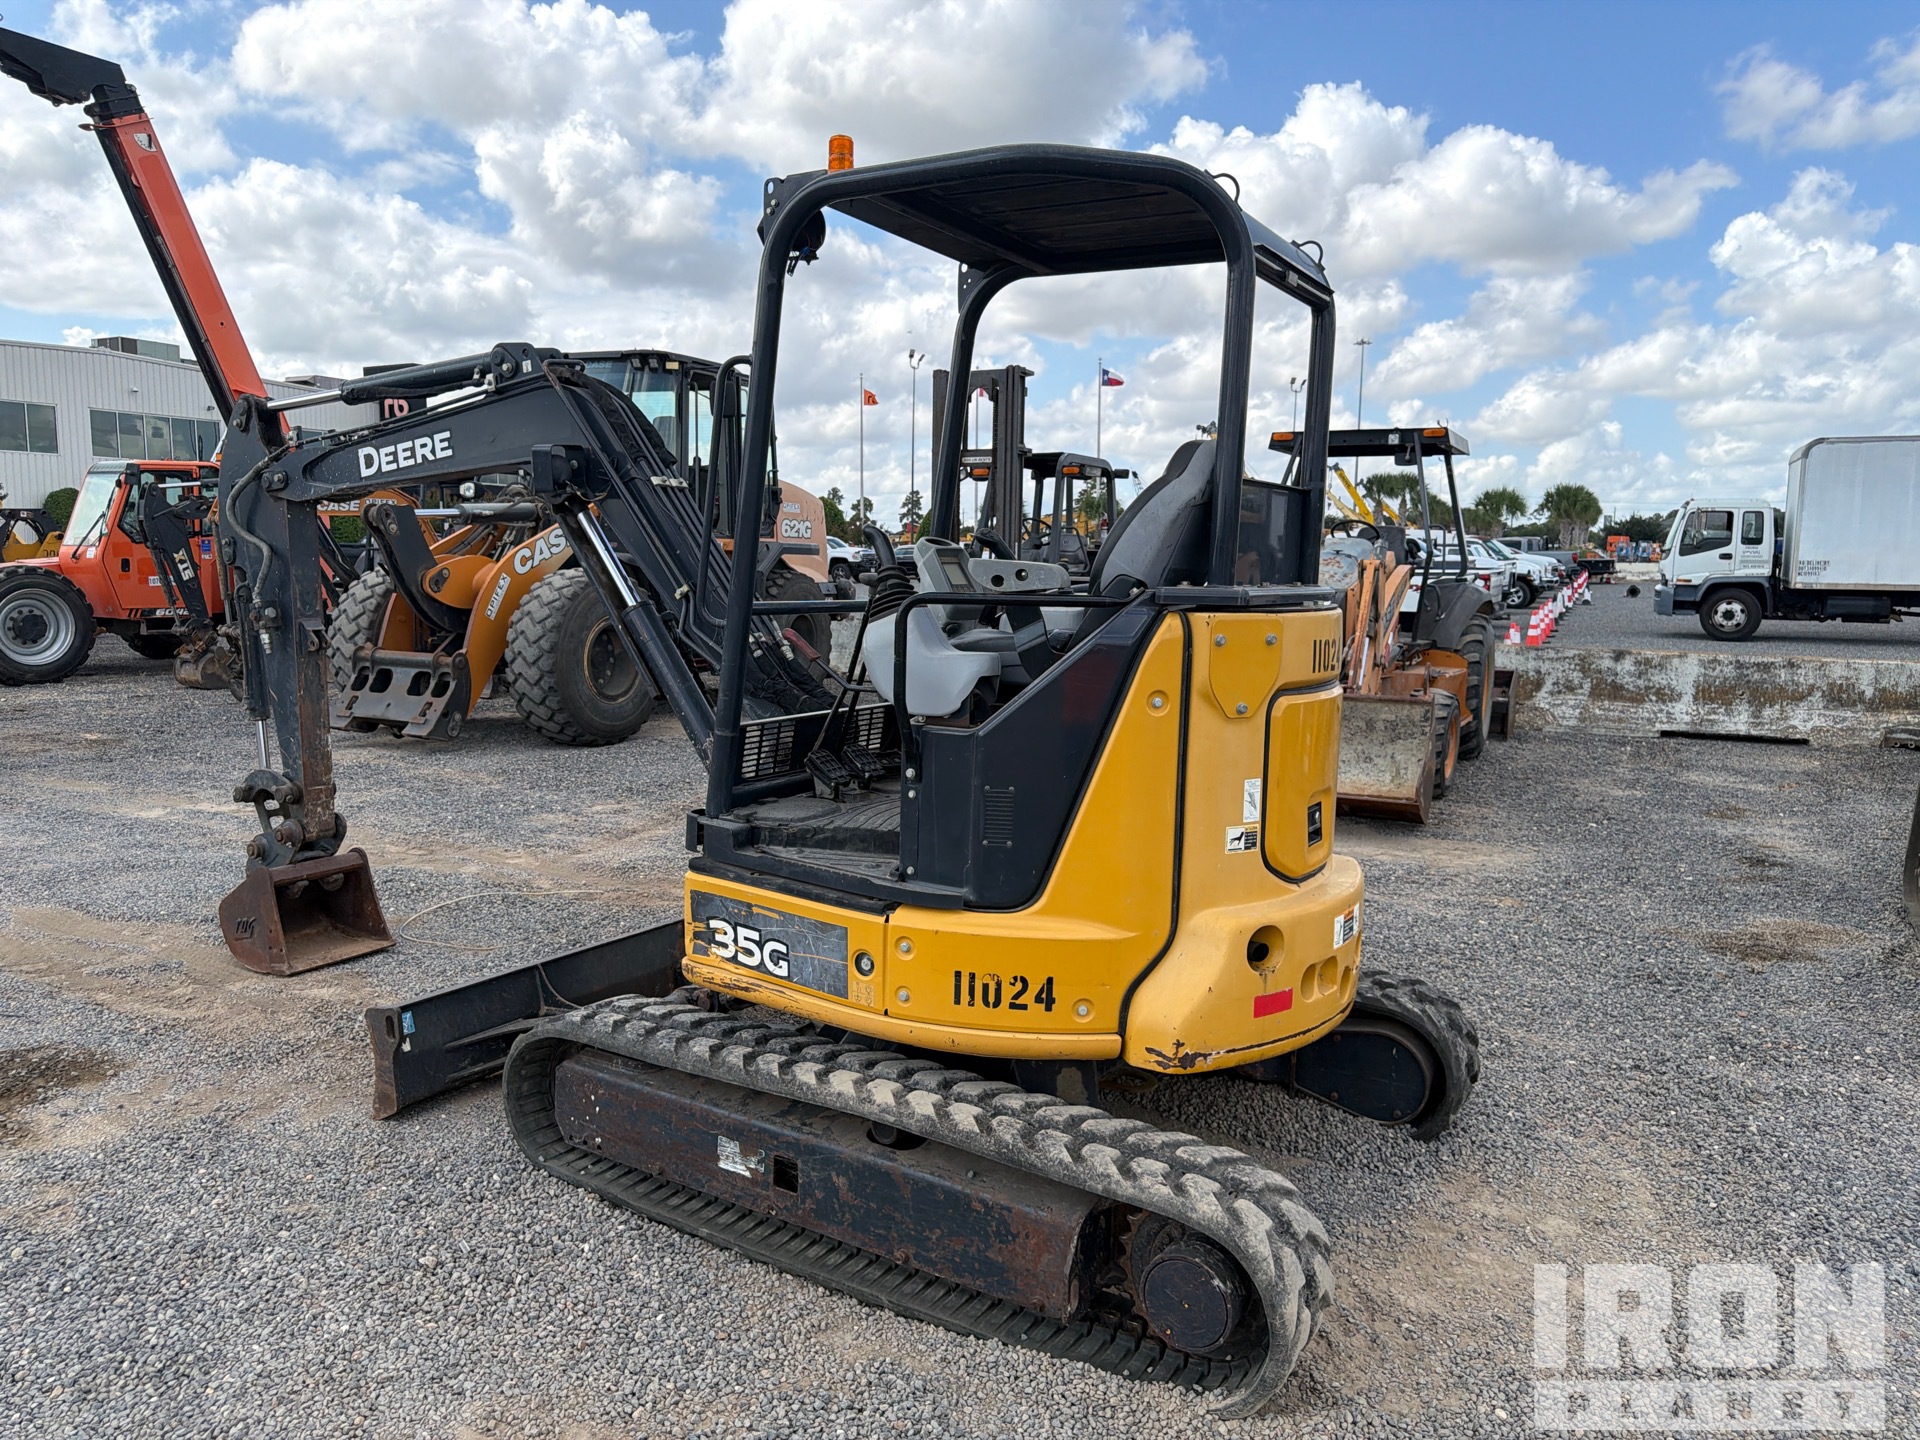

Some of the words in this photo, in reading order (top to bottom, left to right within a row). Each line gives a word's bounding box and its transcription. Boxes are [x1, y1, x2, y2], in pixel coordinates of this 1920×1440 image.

[358, 431, 453, 478] DEERE
[317, 500, 360, 511] CASE
[781, 518, 812, 539] 621G
[514, 528, 571, 575] CAS
[485, 574, 509, 617] OPIFEX
[708, 919, 790, 978] 35G
[953, 970, 1056, 1012] 11024
